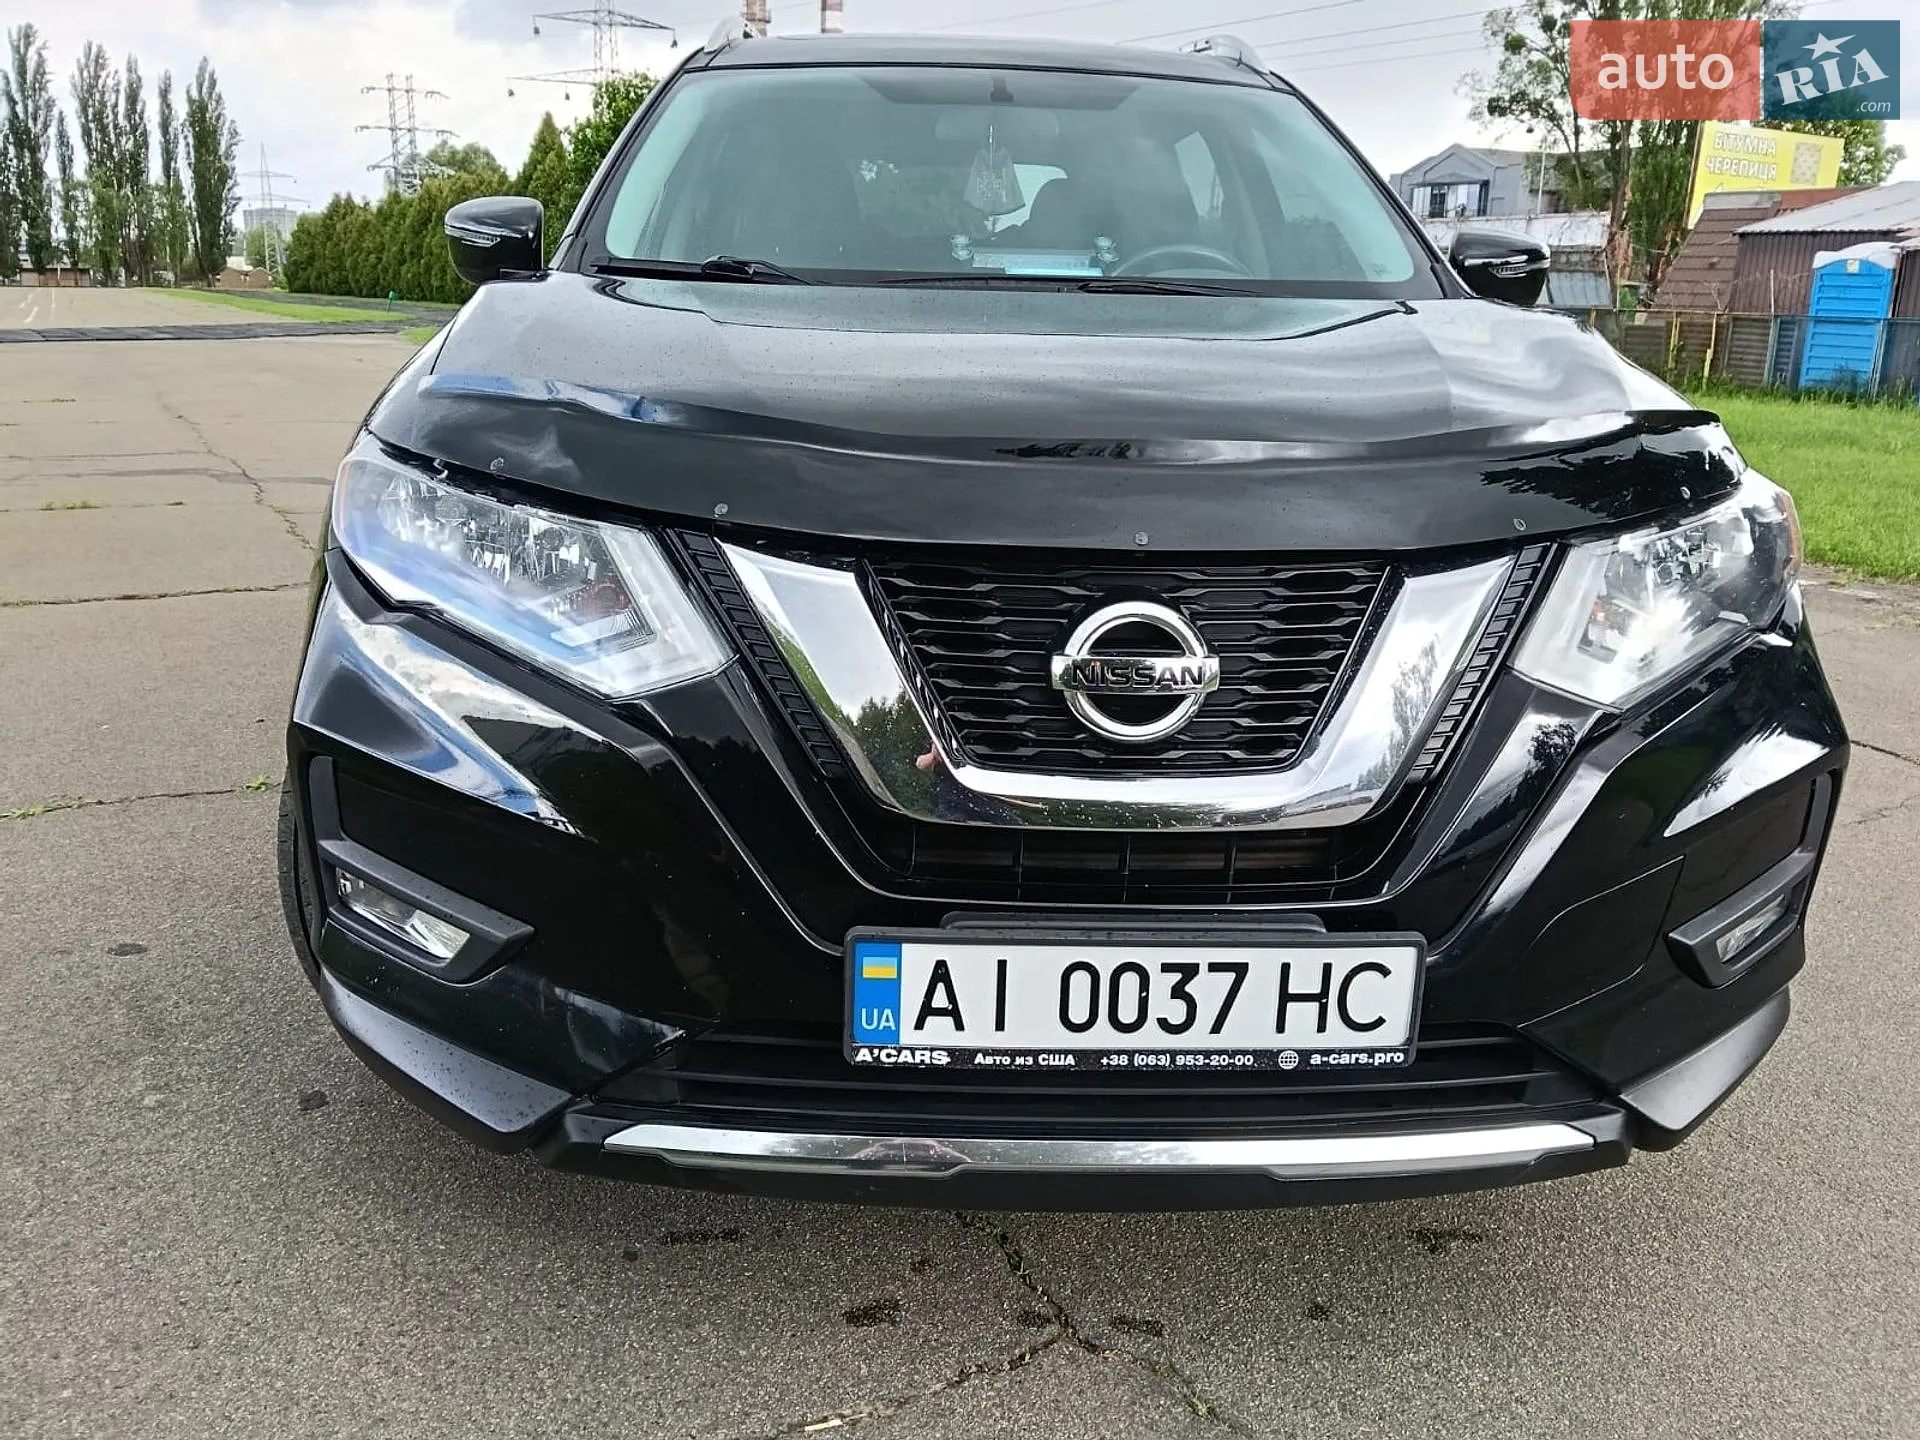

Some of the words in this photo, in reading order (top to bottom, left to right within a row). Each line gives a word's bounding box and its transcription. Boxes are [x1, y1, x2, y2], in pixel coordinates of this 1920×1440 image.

[1713, 132, 1777, 156] БІТУМНА
[1706, 156, 1778, 181] ЧЕРЕПИЦЯ
[1071, 664, 1203, 688] NISSAN
[861, 1008, 897, 1031] UA
[913, 959, 1008, 1032] AI
[1058, 960, 1250, 1036] 0037
[1275, 961, 1393, 1034] HC
[1038, 1053, 1076, 1066] США
[1100, 1054, 1129, 1066] +38
[1133, 1053, 1172, 1067] (063)
[1175, 1054, 1254, 1067] 953-20-00
[1310, 1050, 1405, 1066] a-cars.pro
